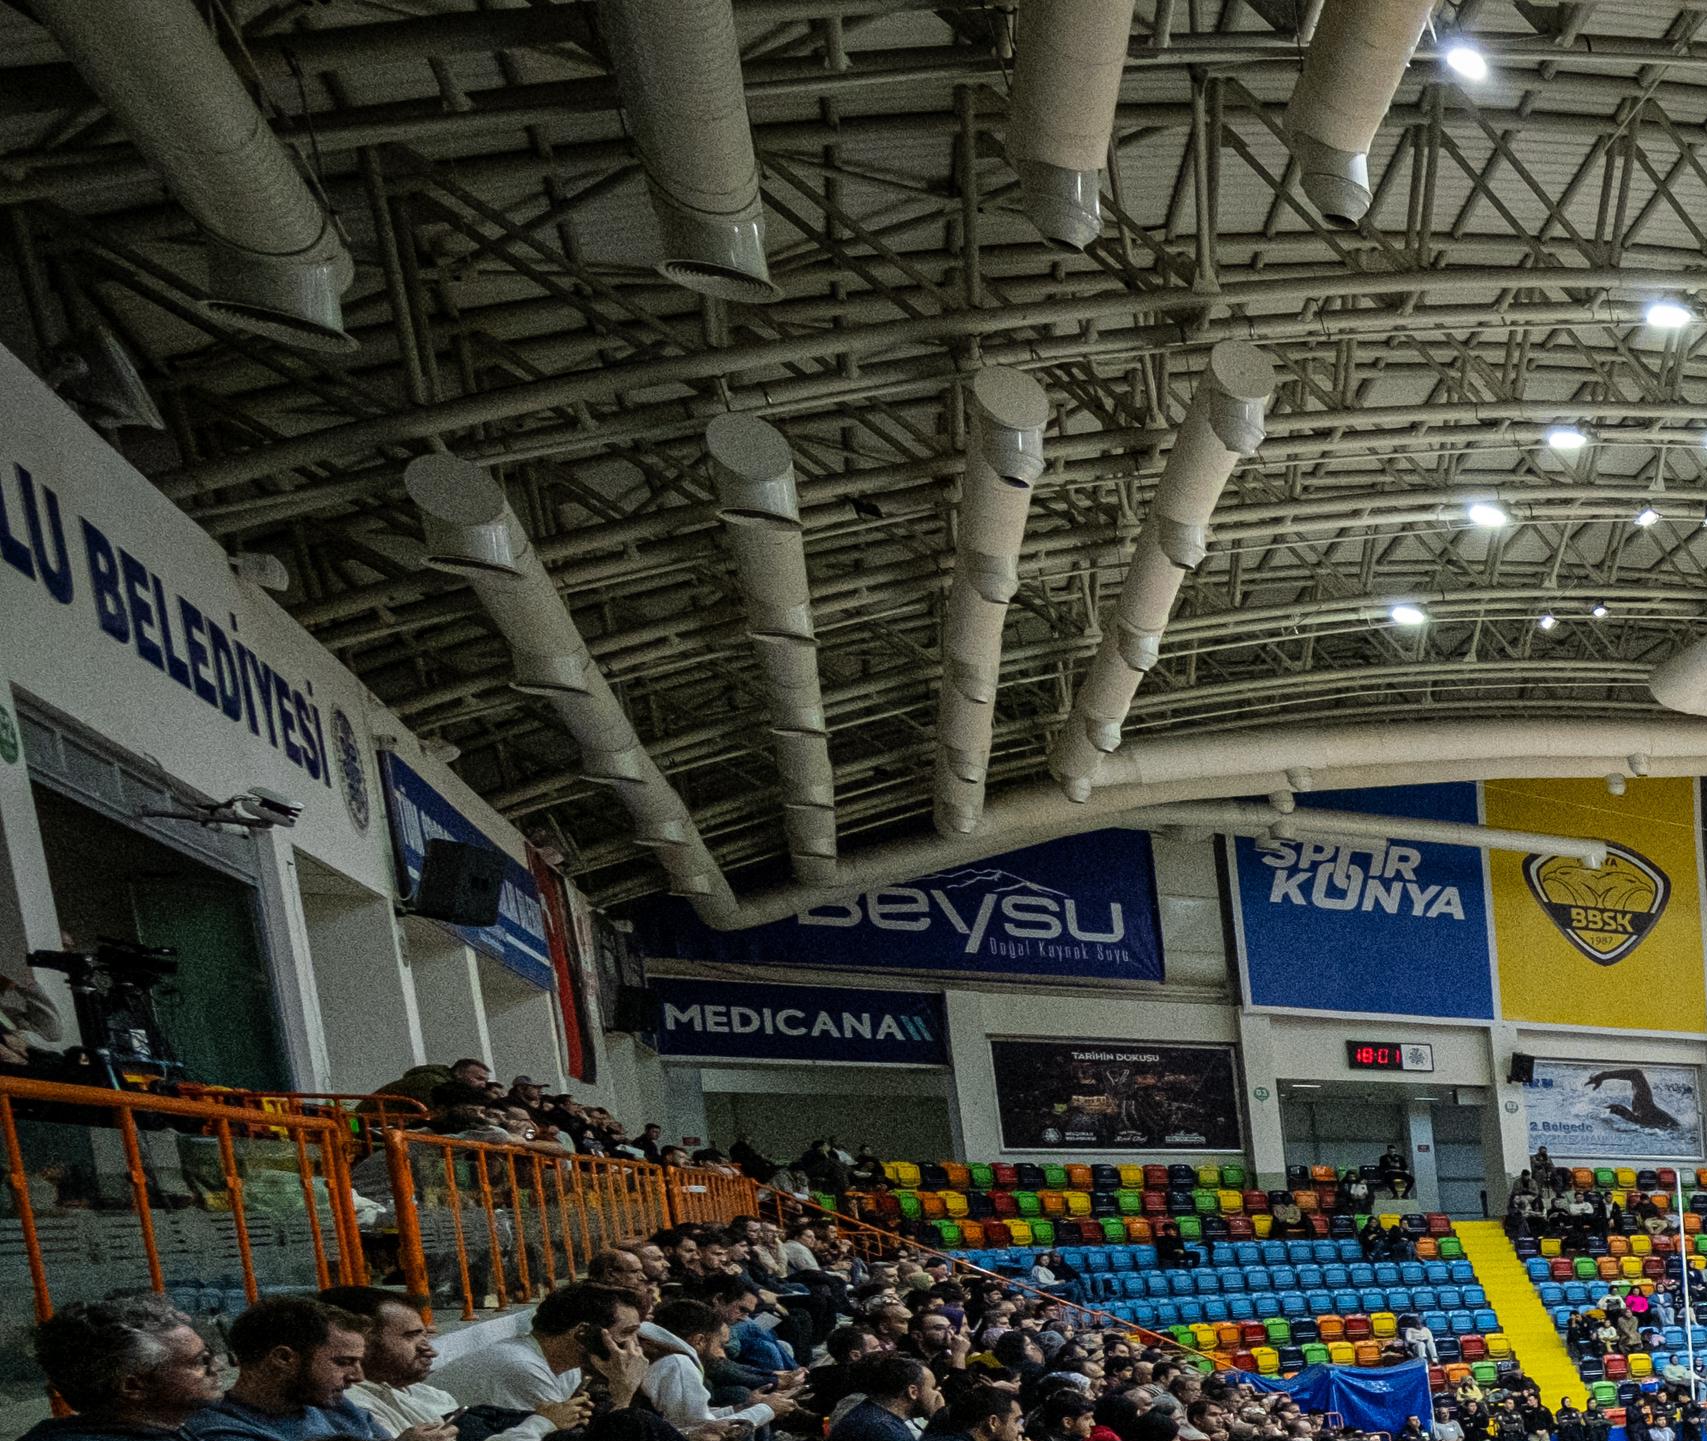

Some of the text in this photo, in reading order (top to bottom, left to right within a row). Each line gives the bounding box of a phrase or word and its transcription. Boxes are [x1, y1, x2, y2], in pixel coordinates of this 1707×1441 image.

[79, 515, 332, 789] BELEDİYESİ
[1270, 863, 1465, 920] KONYA
[664, 1002, 906, 1041] MEDICANA
[1072, 1052, 1114, 1062] TARİHİN
[1356, 1047, 1400, 1064] 18:01
